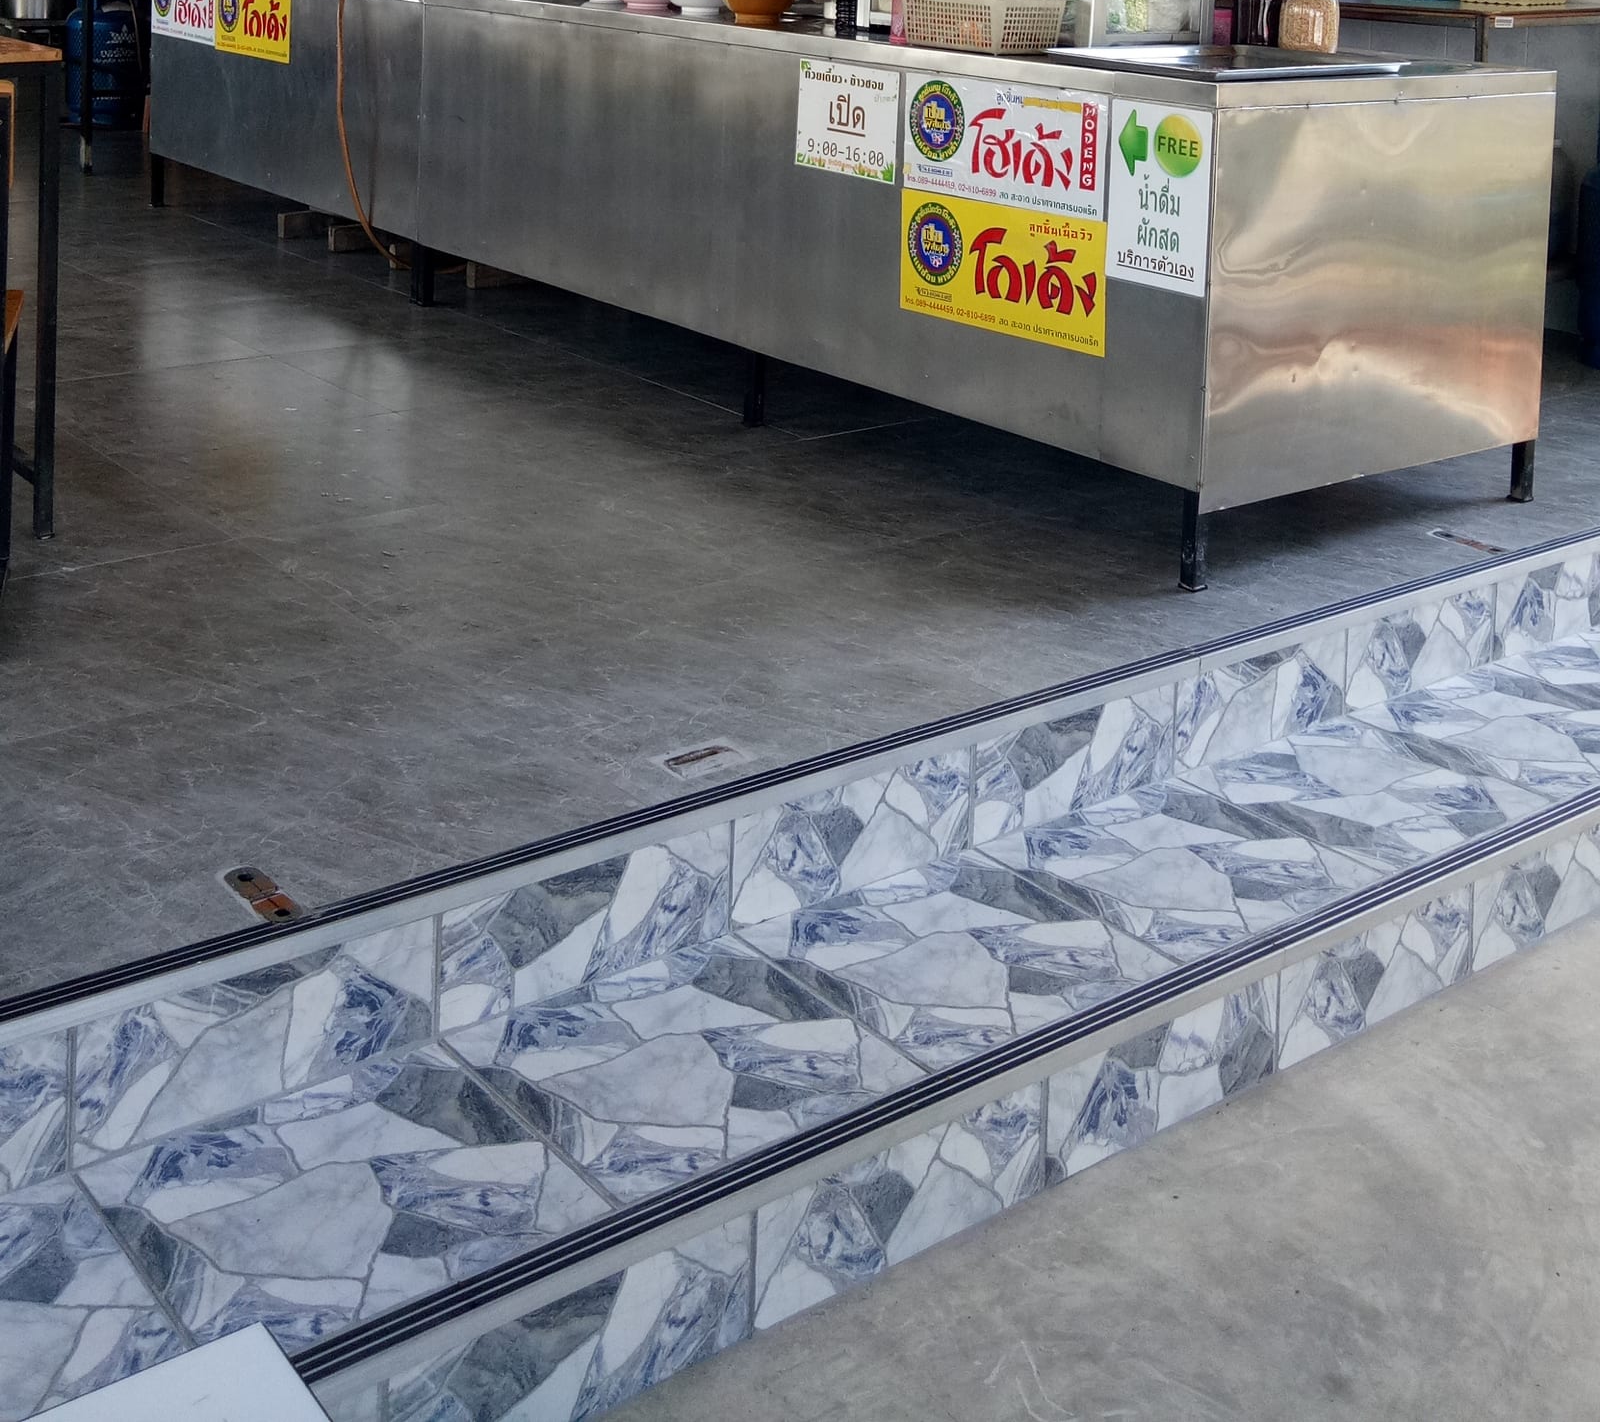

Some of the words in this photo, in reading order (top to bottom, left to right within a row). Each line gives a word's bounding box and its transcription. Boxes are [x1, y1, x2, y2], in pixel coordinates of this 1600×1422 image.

[829, 93, 866, 130] เปิด
[807, 138, 884, 167] 9:00-16:00
[1157, 135, 1199, 158] FREE
[1138, 174, 1181, 217] น้ำดื่ม
[1137, 217, 1180, 254] ผักสด
[969, 226, 1097, 318] โกเด้ง
[1117, 249, 1194, 279] บริการตัวเอง
